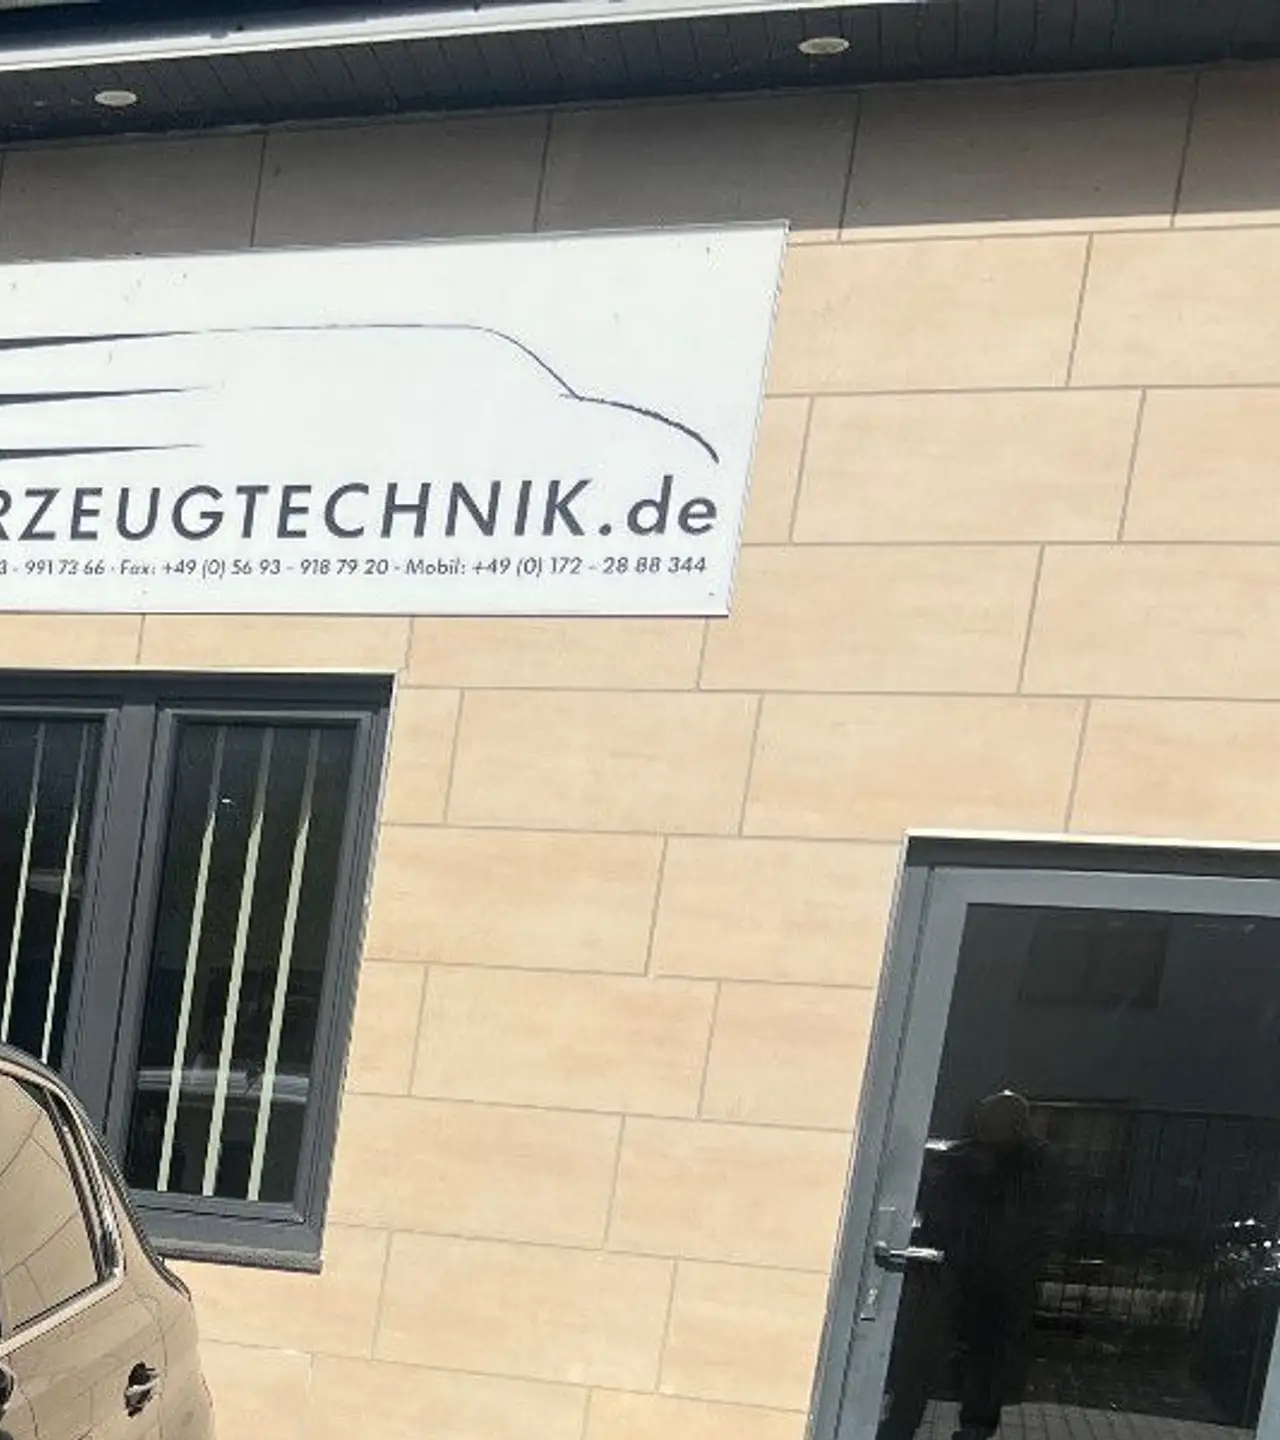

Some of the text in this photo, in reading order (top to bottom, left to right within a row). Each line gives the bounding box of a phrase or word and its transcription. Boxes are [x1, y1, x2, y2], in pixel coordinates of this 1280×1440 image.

[83, 559, 106, 576] 66
[120, 559, 156, 576] Fax:
[163, 558, 197, 576] +49
[202, 558, 227, 580] (0)
[231, 558, 253, 576] 56
[259, 558, 281, 576] 93
[301, 558, 331, 576] 918
[337, 558, 358, 576] 79
[364, 558, 390, 576] 20
[405, 557, 466, 576] Mobil:
[471, 556, 512, 575] +49
[516, 556, 543, 579] (0)
[551, 556, 584, 575] 172
[603, 556, 629, 575] 28
[635, 556, 662, 575] 88
[668, 556, 707, 575] 344
